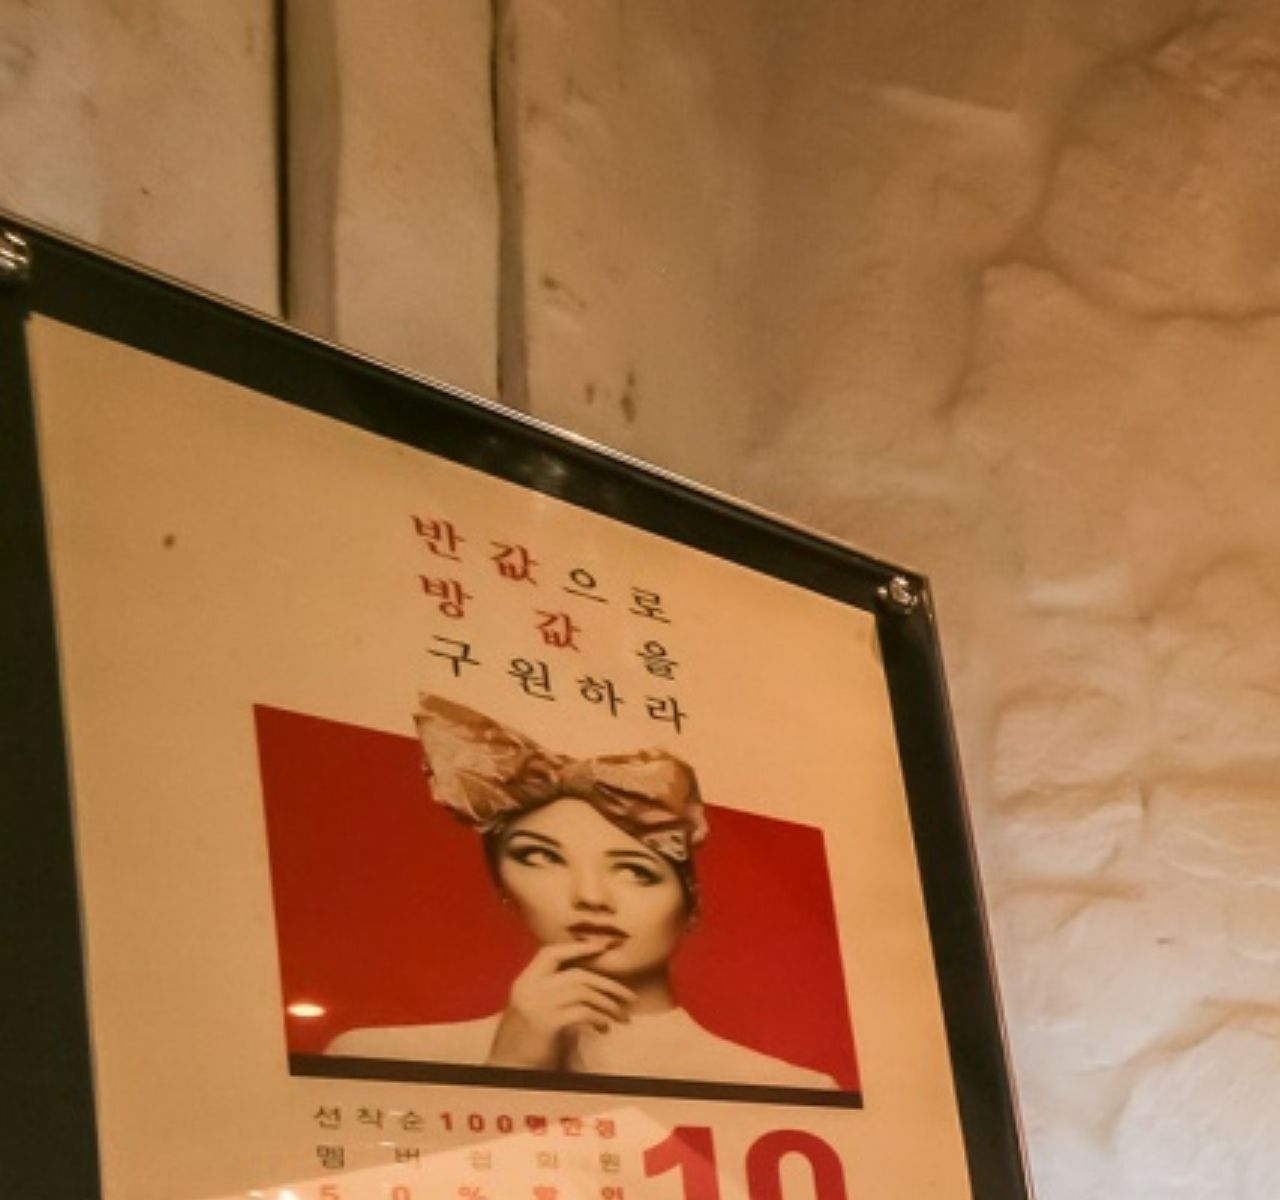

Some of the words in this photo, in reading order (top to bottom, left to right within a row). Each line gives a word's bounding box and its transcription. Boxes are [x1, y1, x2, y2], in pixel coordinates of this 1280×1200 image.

[410, 514, 671, 623] 반값으로
[418, 575, 678, 680] 방값을
[425, 635, 688, 734] 구원하라
